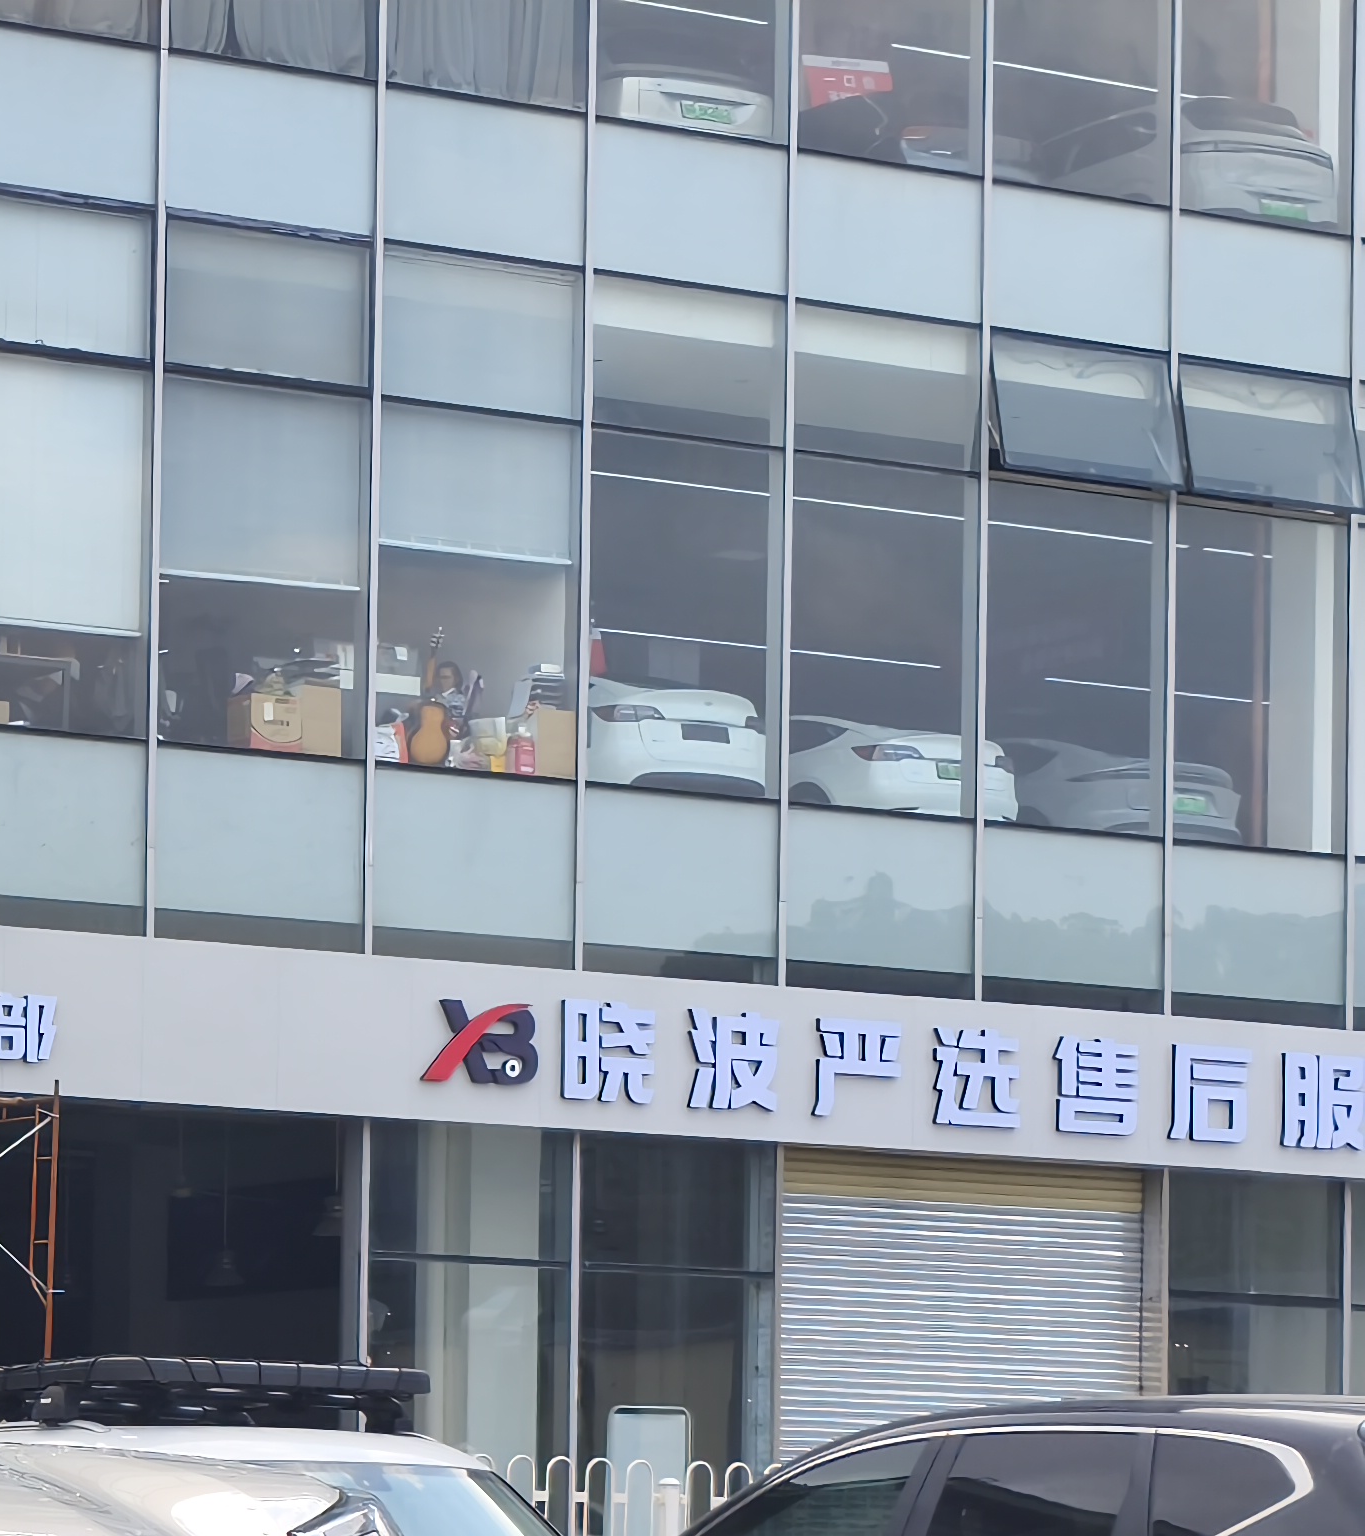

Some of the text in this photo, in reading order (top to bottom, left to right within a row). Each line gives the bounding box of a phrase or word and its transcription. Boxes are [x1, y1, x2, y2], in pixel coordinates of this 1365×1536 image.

[559, 998, 1365, 1151] 晓波严选售后服
